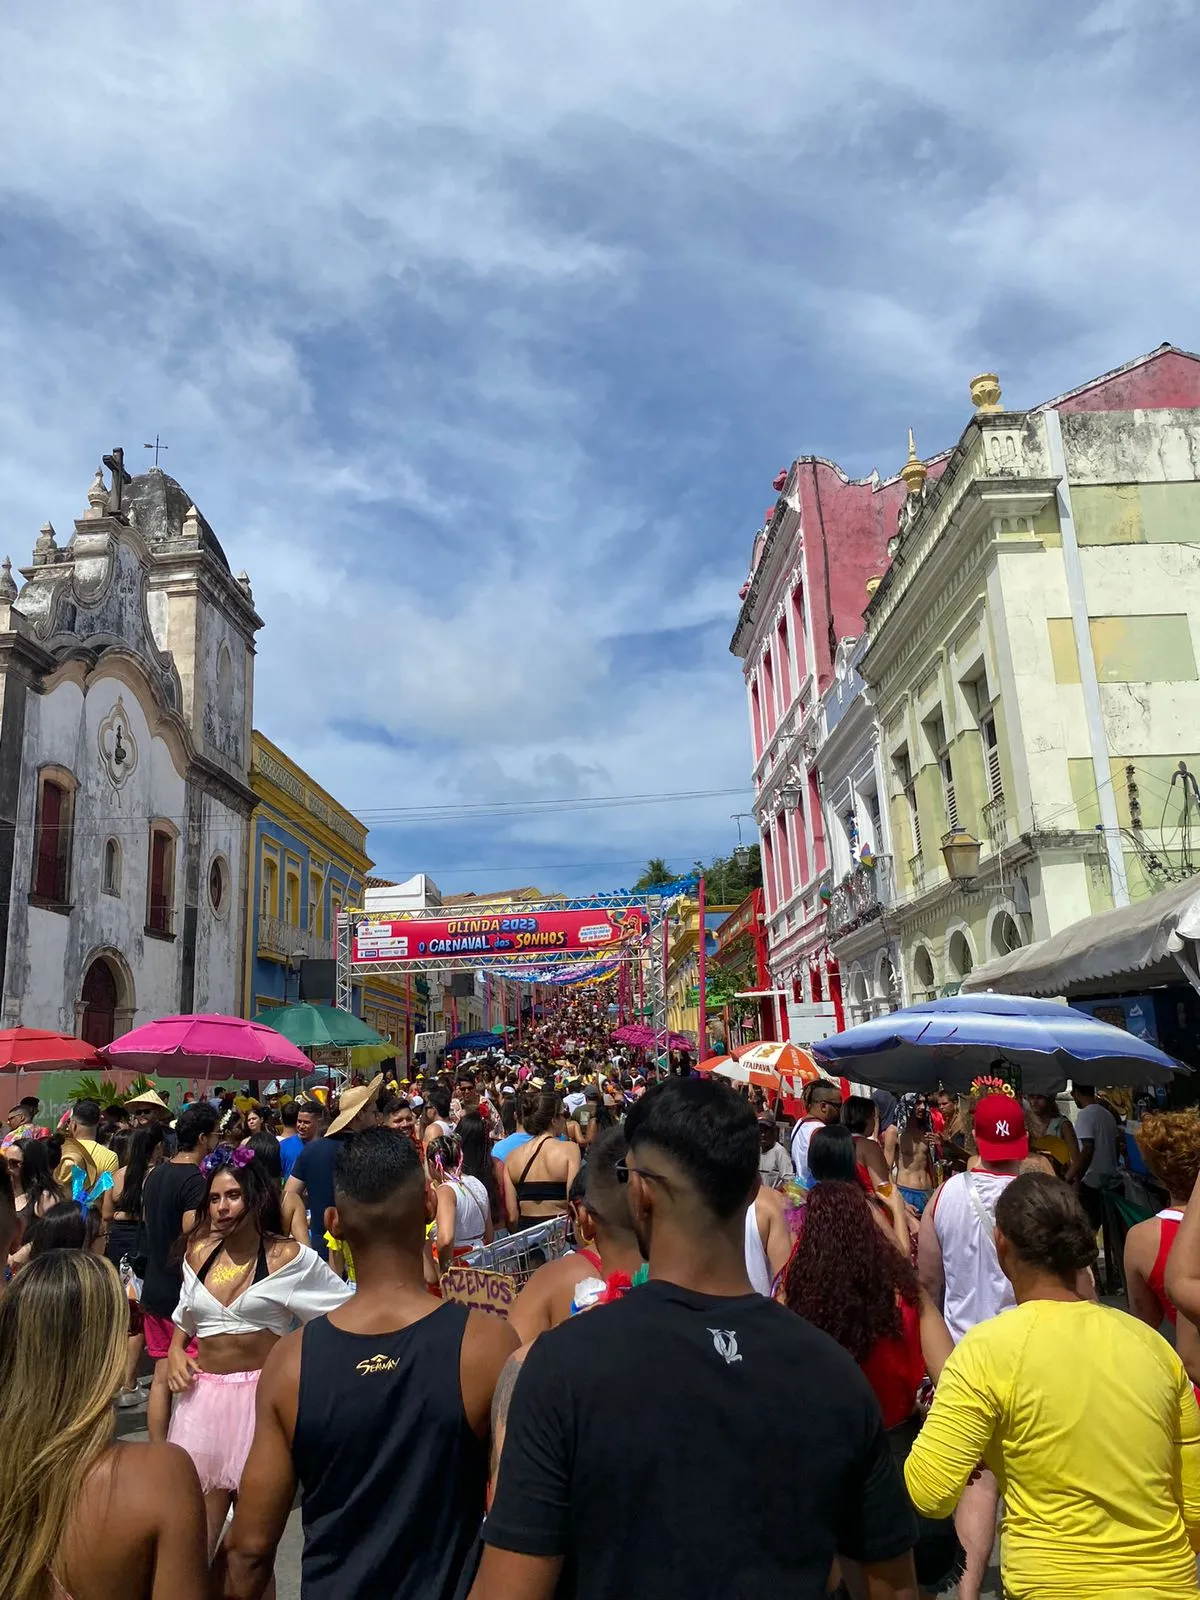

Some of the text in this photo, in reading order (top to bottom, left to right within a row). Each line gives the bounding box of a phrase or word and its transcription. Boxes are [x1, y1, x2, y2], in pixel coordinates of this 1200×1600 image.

[447, 918, 536, 934] OLINDA 2023
[429, 935, 491, 953] CARNAVAL
[494, 936, 510, 948] dos
[514, 931, 565, 949] SONHOS
[742, 1060, 772, 1073] ITAIPAVA
